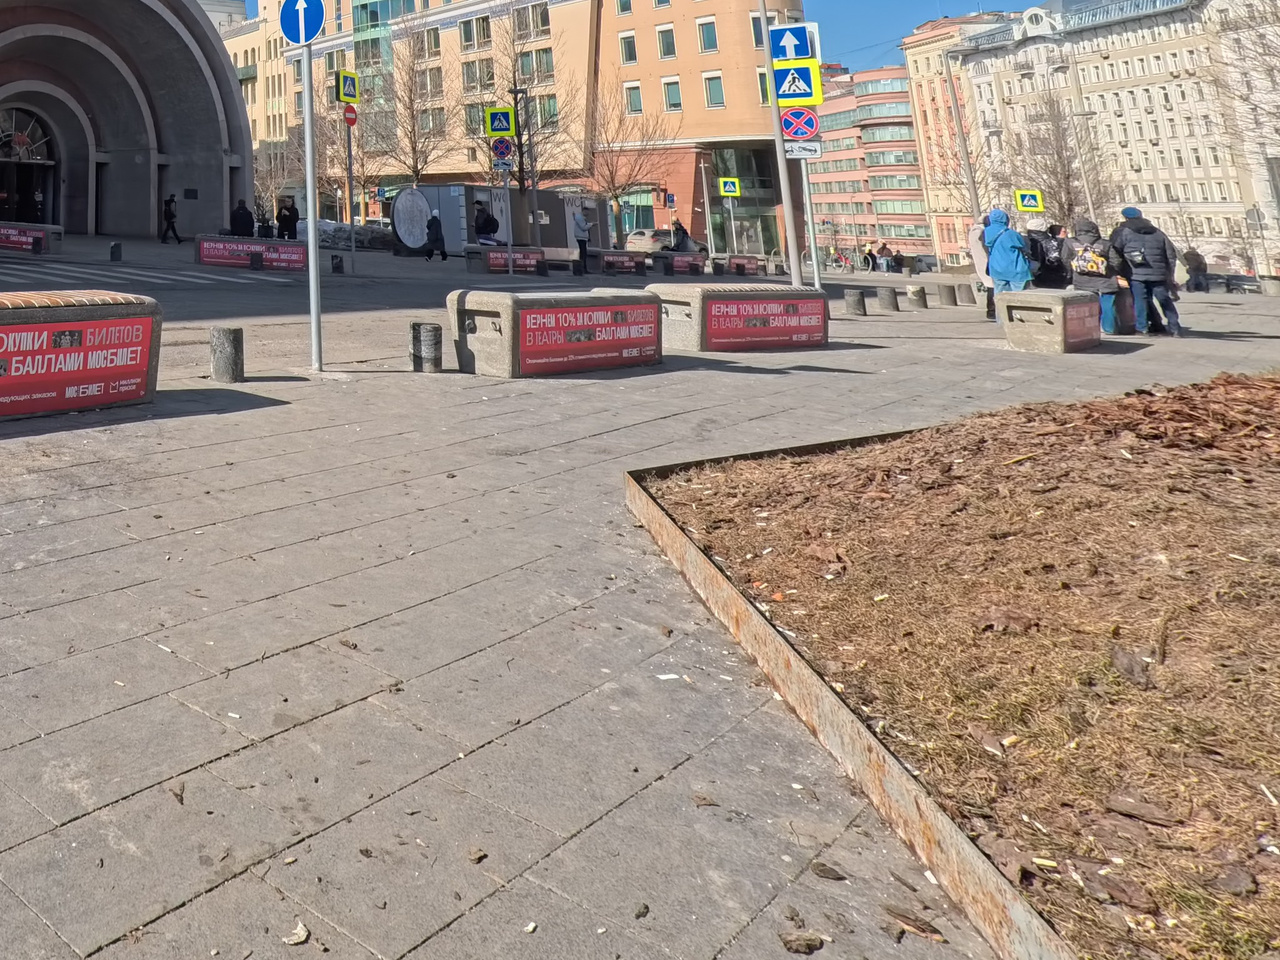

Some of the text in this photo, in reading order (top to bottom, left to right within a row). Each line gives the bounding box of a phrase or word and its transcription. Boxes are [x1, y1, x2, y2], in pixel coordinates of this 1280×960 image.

[566, 198, 580, 208] WC
[739, 304, 752, 315] 10%
[526, 314, 555, 329] ВЕРНЕМ
[557, 312, 575, 327] 10%
[711, 317, 718, 329] В
[86, 325, 143, 346] БИЛЕТОВ
[526, 332, 533, 346] В
[535, 330, 564, 345] ТЕАТРЫ
[596, 326, 629, 341] БАЛЛАМИ
[11, 352, 84, 376] БАЛЛАМИ
[87, 347, 142, 370] МОСБИЛЕТ
